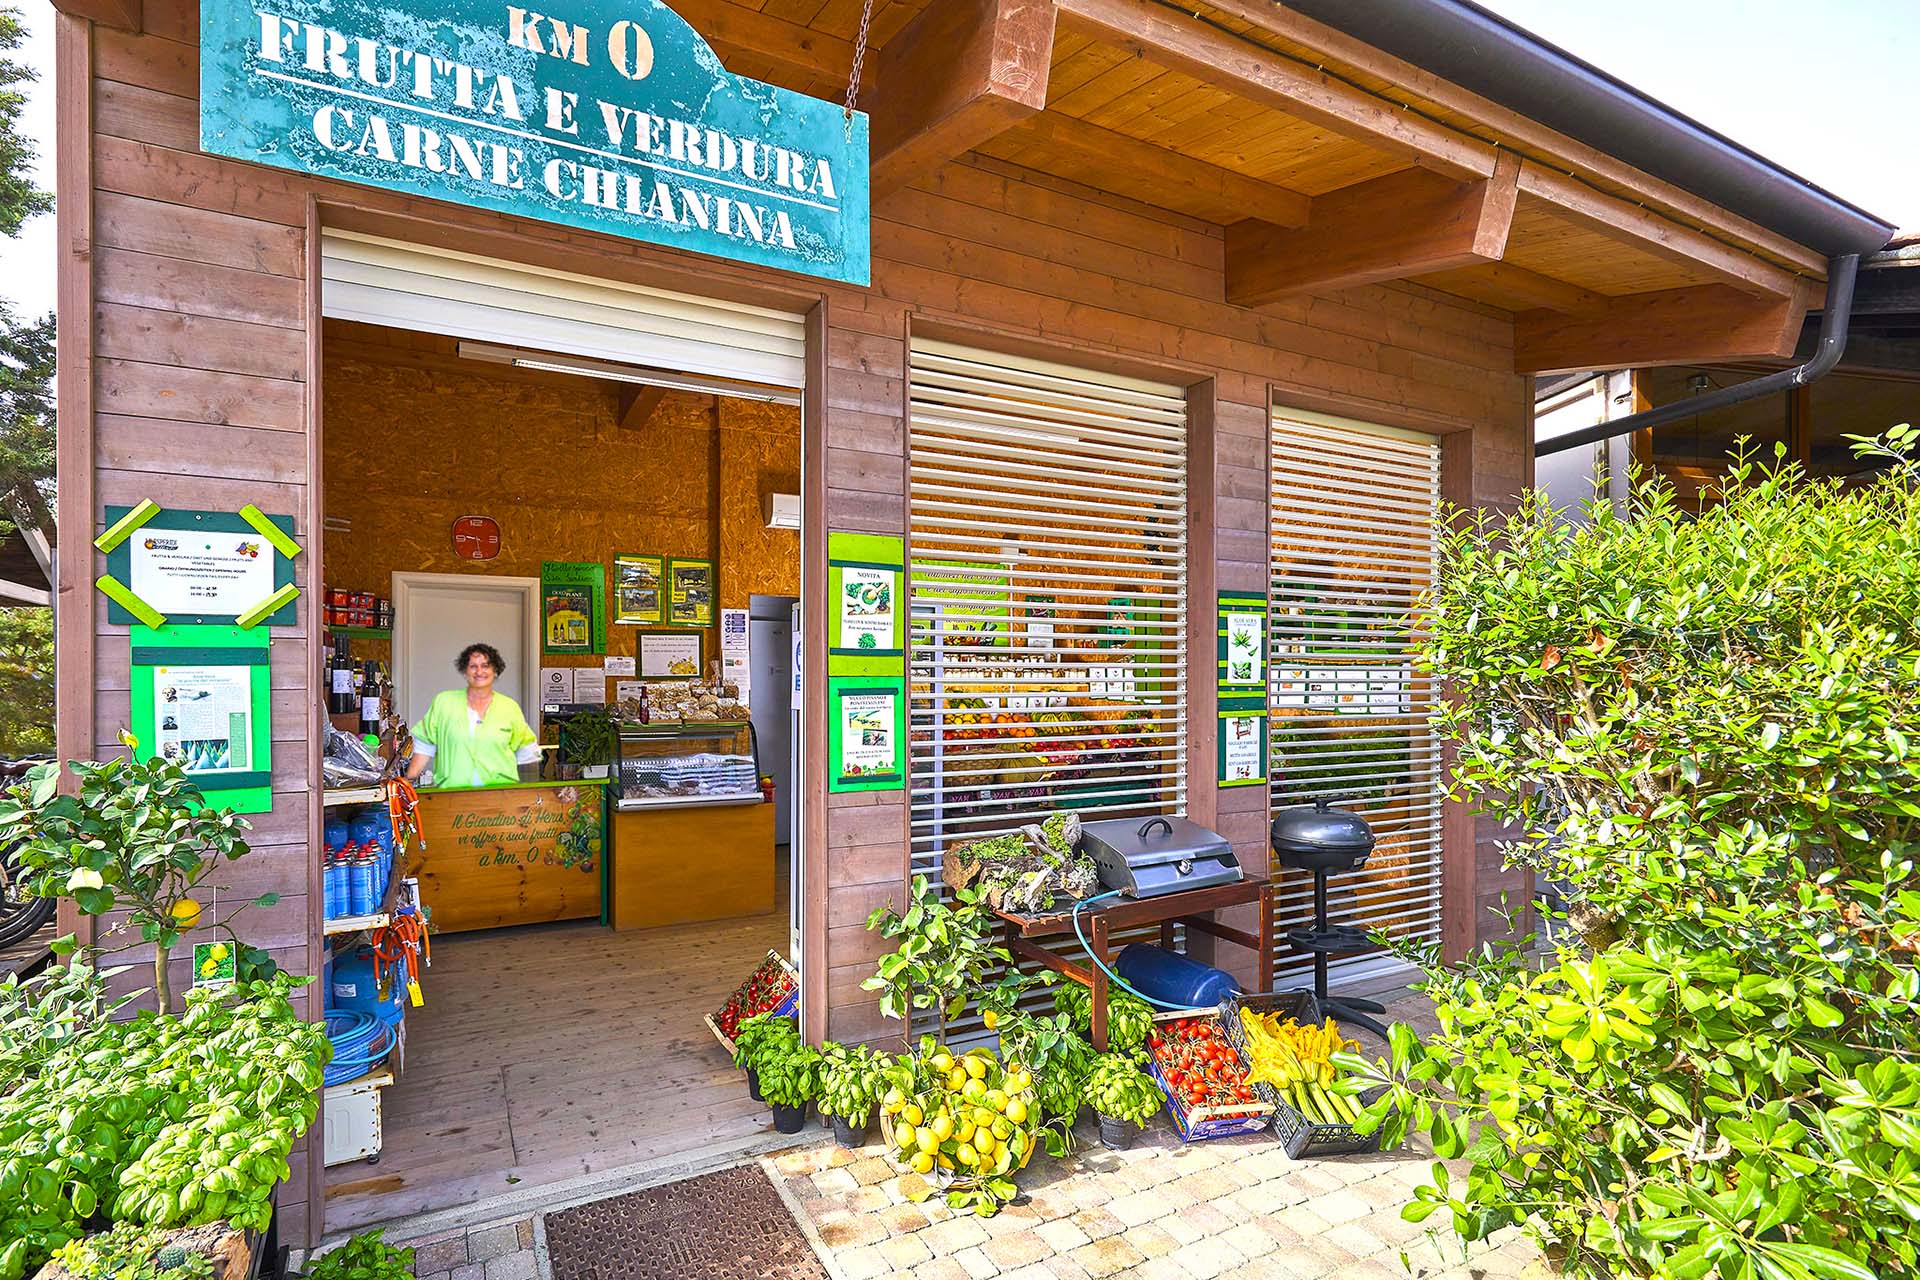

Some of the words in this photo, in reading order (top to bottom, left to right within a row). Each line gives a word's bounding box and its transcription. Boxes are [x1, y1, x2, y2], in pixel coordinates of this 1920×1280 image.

[507, 6, 588, 67] KM
[257, 11, 523, 122] FRUTTA
[545, 92, 580, 137] E
[597, 106, 838, 200] VERDURA
[312, 104, 525, 188] CARNE
[544, 157, 797, 251] CHIANINA
[471, 831, 496, 848] offre
[506, 831, 529, 842] suoi
[480, 854, 491, 867] a
